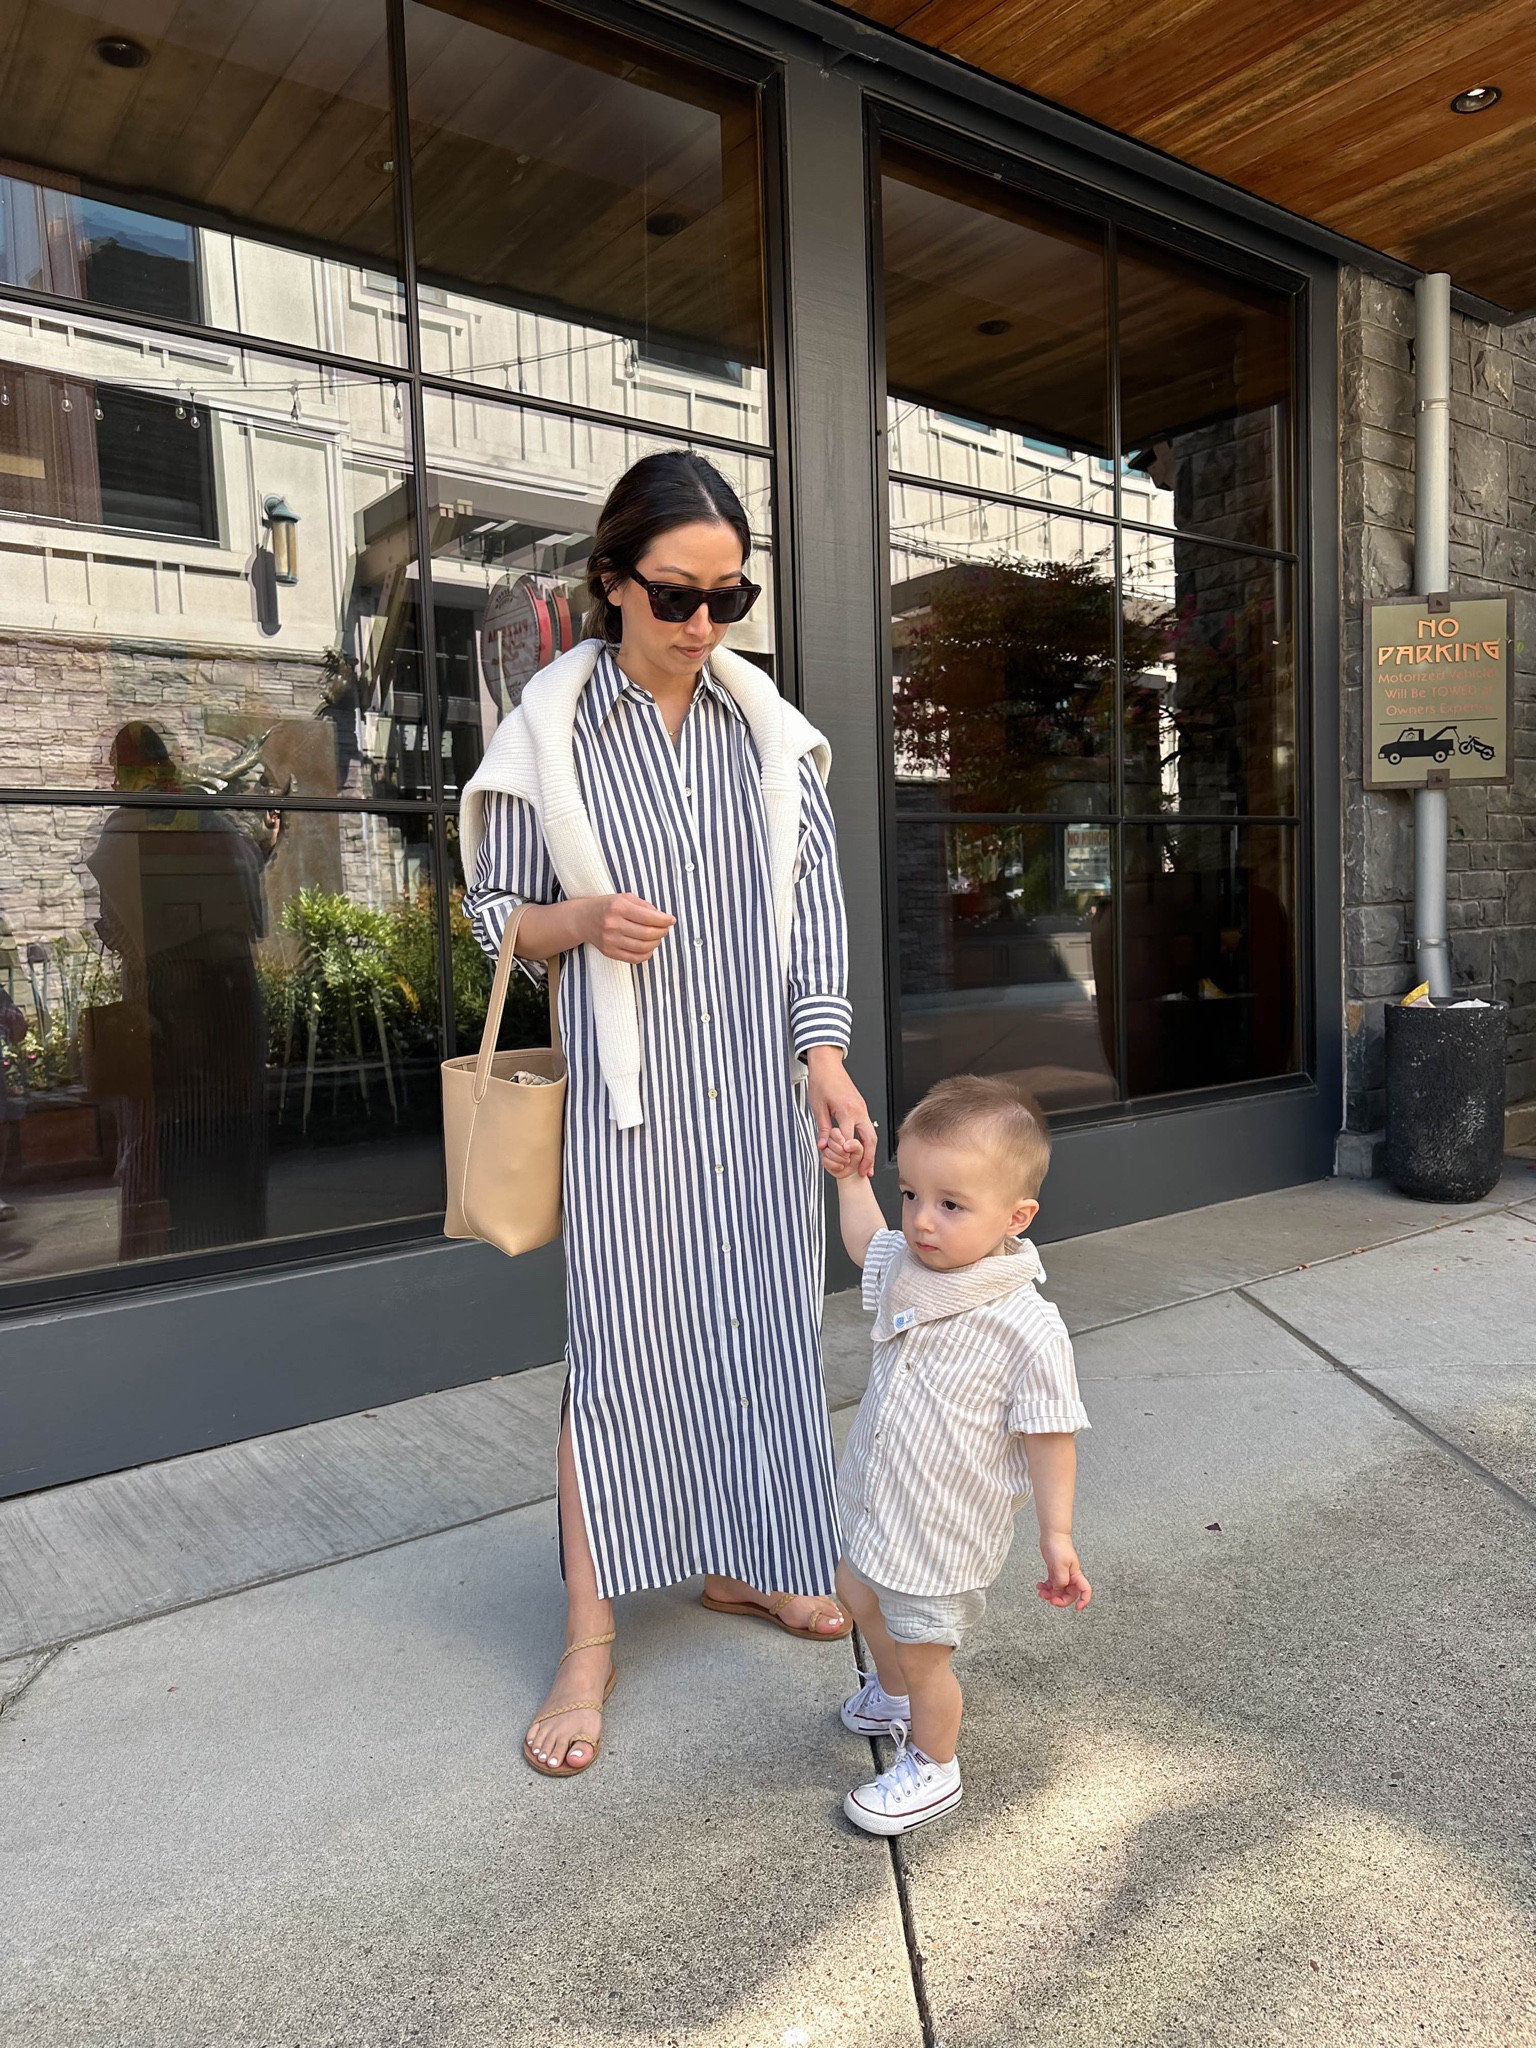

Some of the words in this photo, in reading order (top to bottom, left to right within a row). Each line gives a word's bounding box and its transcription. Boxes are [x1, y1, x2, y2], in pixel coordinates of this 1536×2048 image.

[1418, 617, 1460, 639] NO
[1377, 640, 1501, 666] PARKING
[1378, 669, 1446, 683] Motorized
[1449, 667, 1501, 680] Vehicles
[1385, 688, 1407, 699] Will
[1411, 687, 1427, 699] Be
[1431, 685, 1478, 697] TOWED
[1386, 704, 1436, 716] Owners
[1440, 702, 1492, 716] Expense
